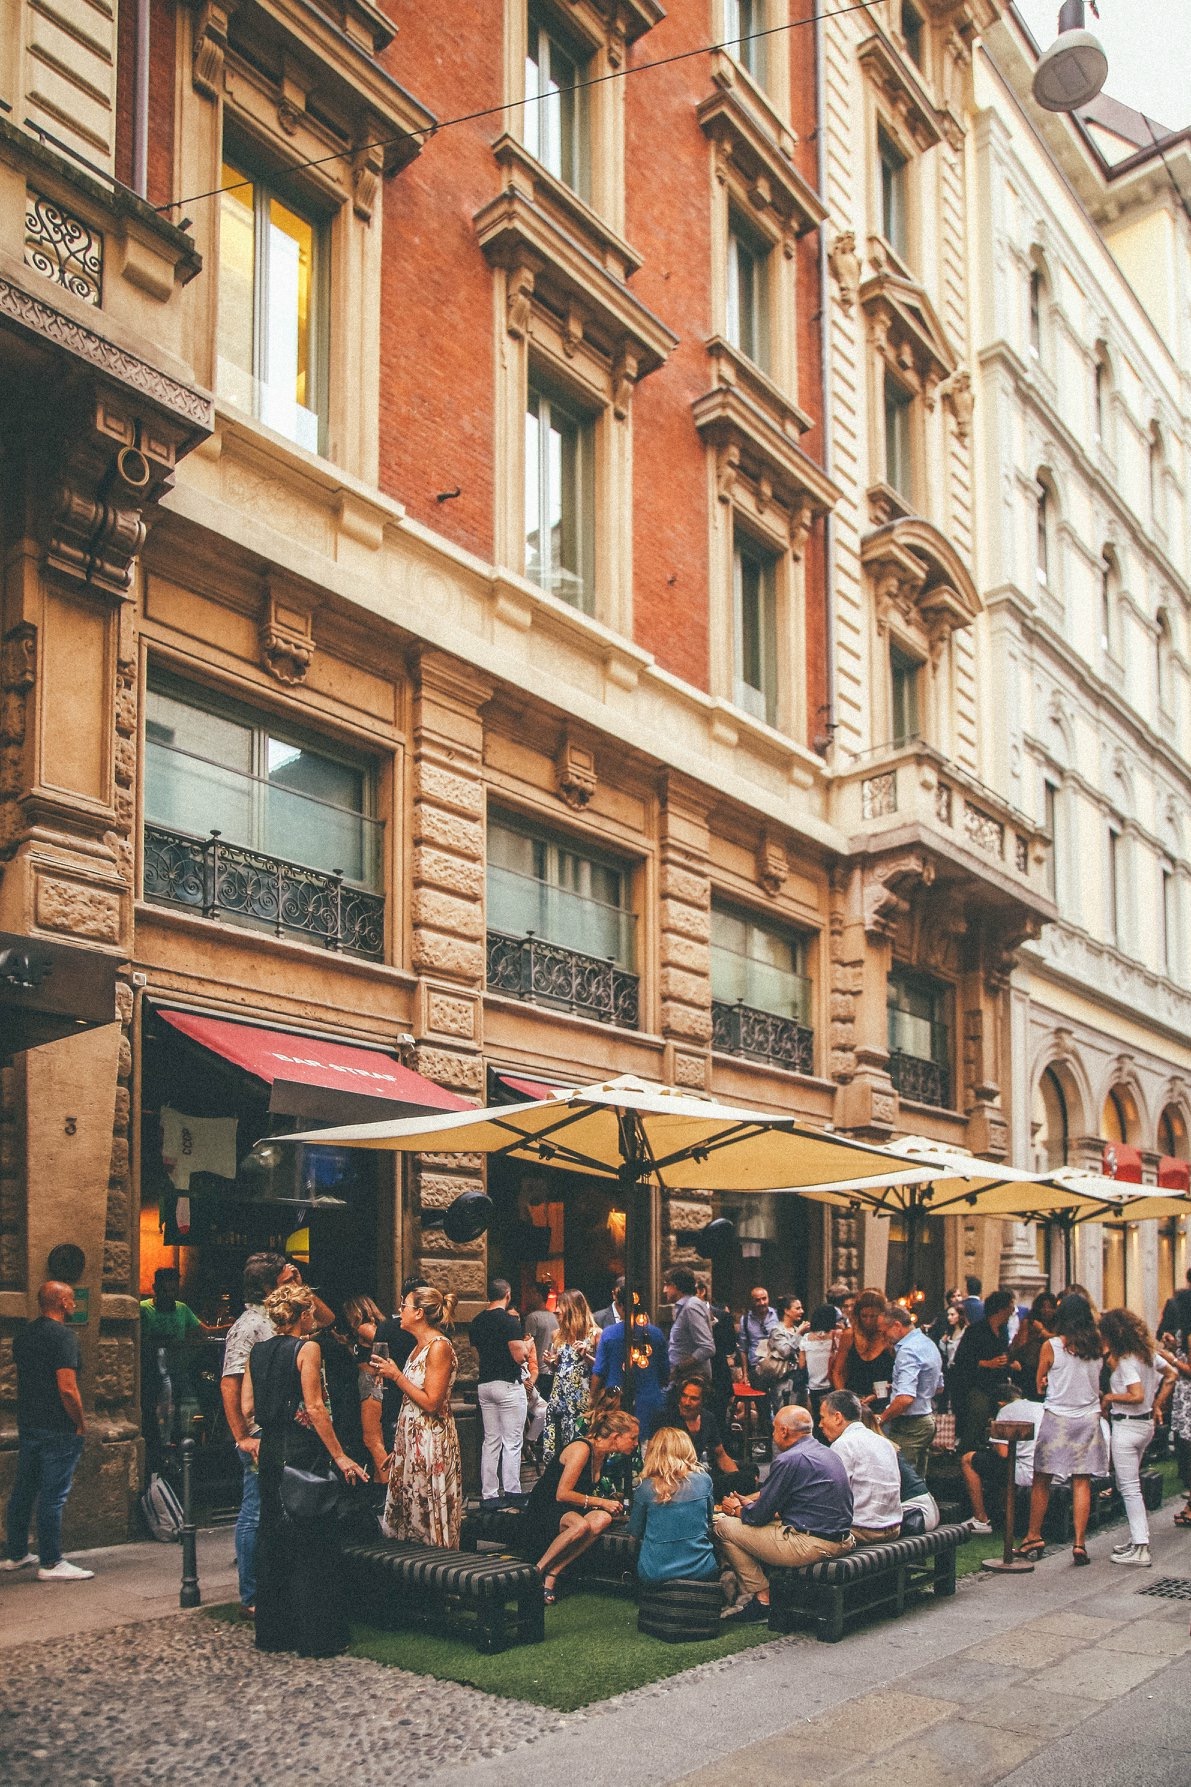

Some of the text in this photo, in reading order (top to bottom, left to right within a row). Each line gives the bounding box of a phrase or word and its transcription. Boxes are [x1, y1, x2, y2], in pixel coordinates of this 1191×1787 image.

[272, 1053, 397, 1082] BAR STRAF
[65, 1117, 77, 1135] 3
